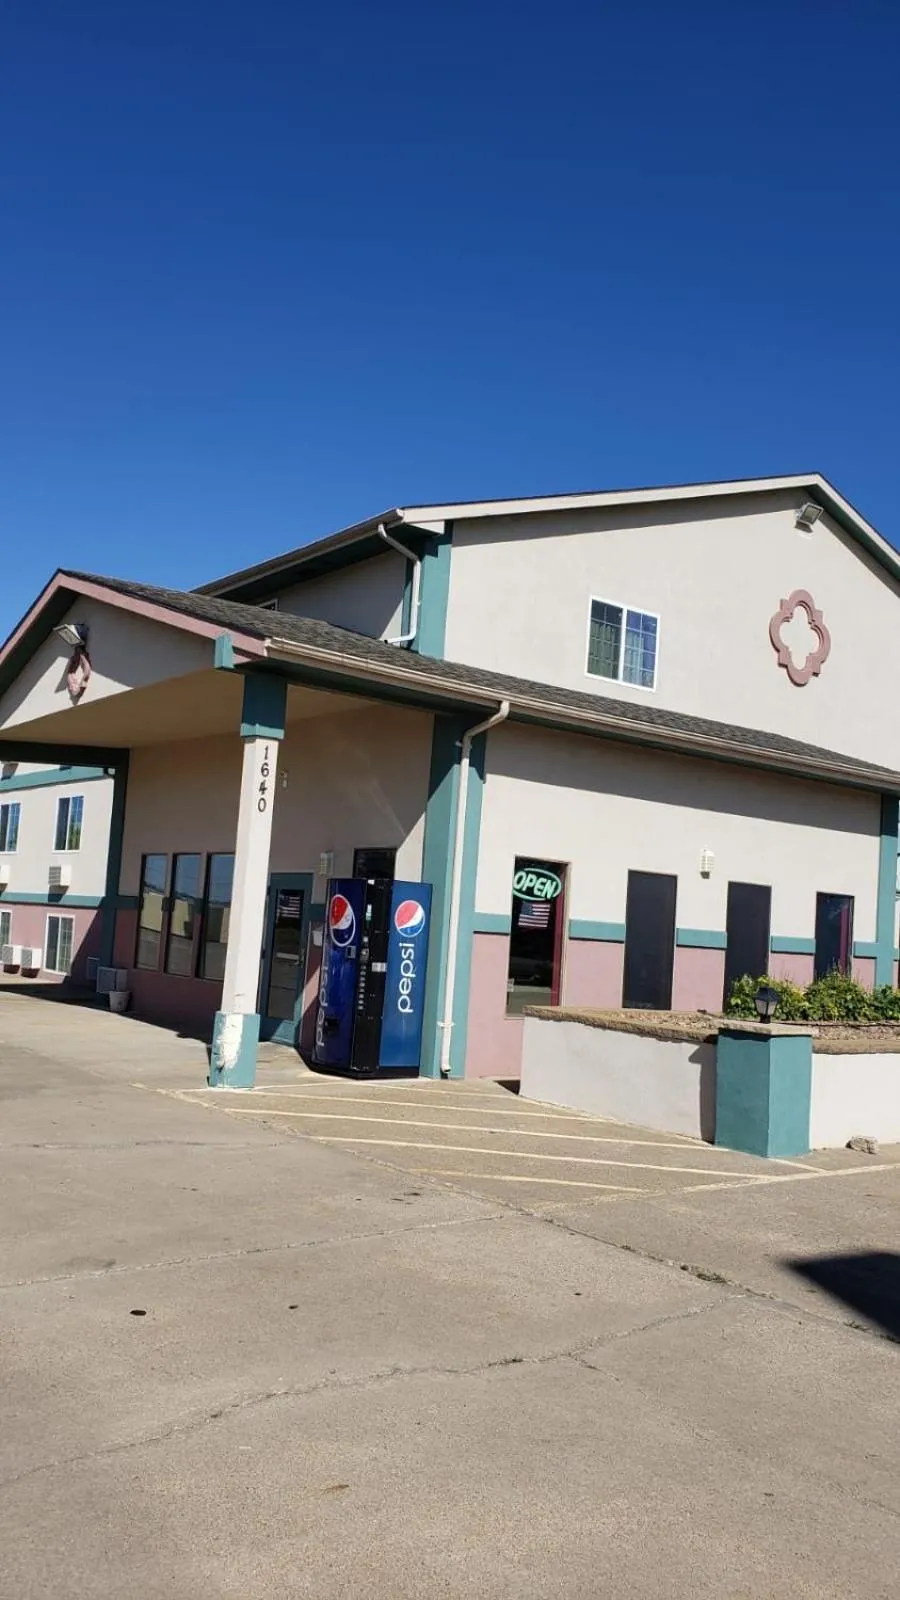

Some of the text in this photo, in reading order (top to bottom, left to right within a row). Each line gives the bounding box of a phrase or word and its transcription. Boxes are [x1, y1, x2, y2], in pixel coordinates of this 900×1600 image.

[257, 745, 270, 813] 1640
[513, 871, 556, 899] OPEN
[316, 963, 328, 1046] pepsi
[397, 942, 416, 1013] pepsi
